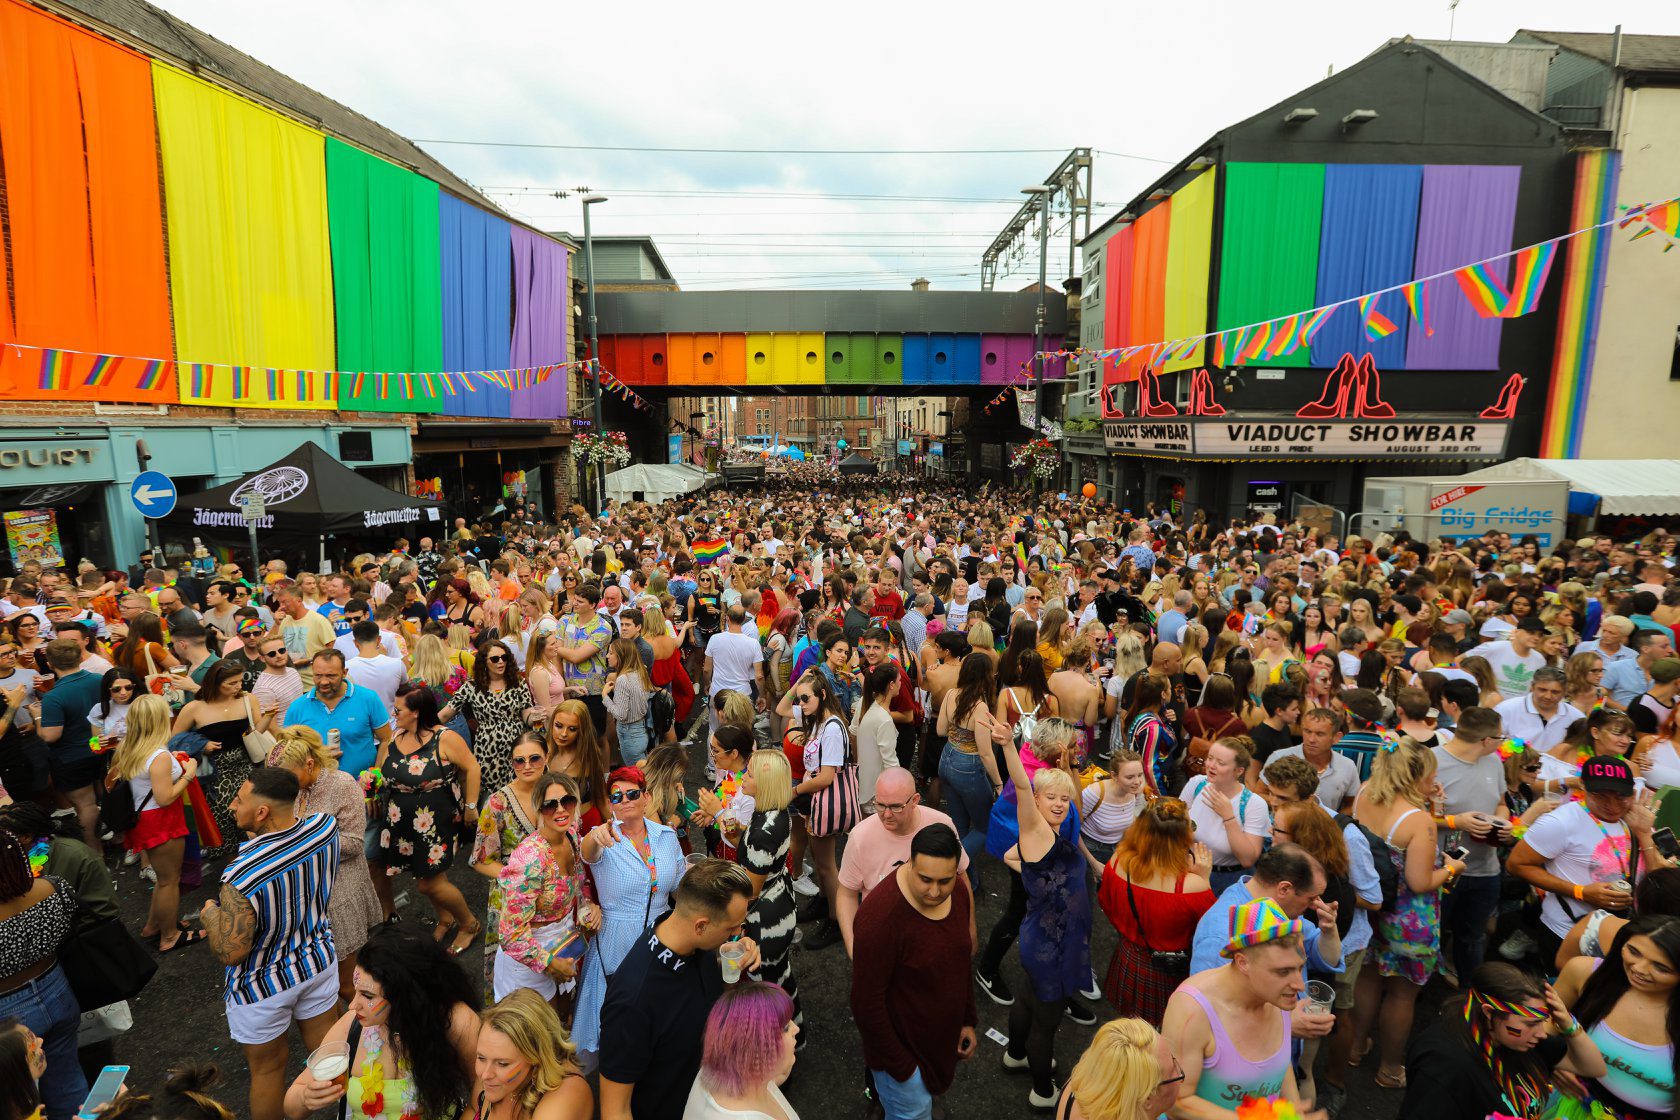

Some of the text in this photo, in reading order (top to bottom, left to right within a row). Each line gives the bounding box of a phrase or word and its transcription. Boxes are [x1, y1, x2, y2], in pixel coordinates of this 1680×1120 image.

[1104, 424, 1138, 439] VIADUCT
[1227, 425, 1476, 442] VIADUCT SHOWBAR
[1289, 445, 1314, 453] PRIDE
[1386, 445, 1482, 453] AUGUST 3RD 4TH
[1256, 486, 1278, 496] cash
[1431, 486, 1467, 509] FOR HIRE
[363, 506, 420, 528] Jägermeister
[1440, 506, 1553, 529] Big Fridge
[875, 604, 893, 613] VANS
[1588, 764, 1627, 779] ICON
[648, 923, 686, 971] RRY
